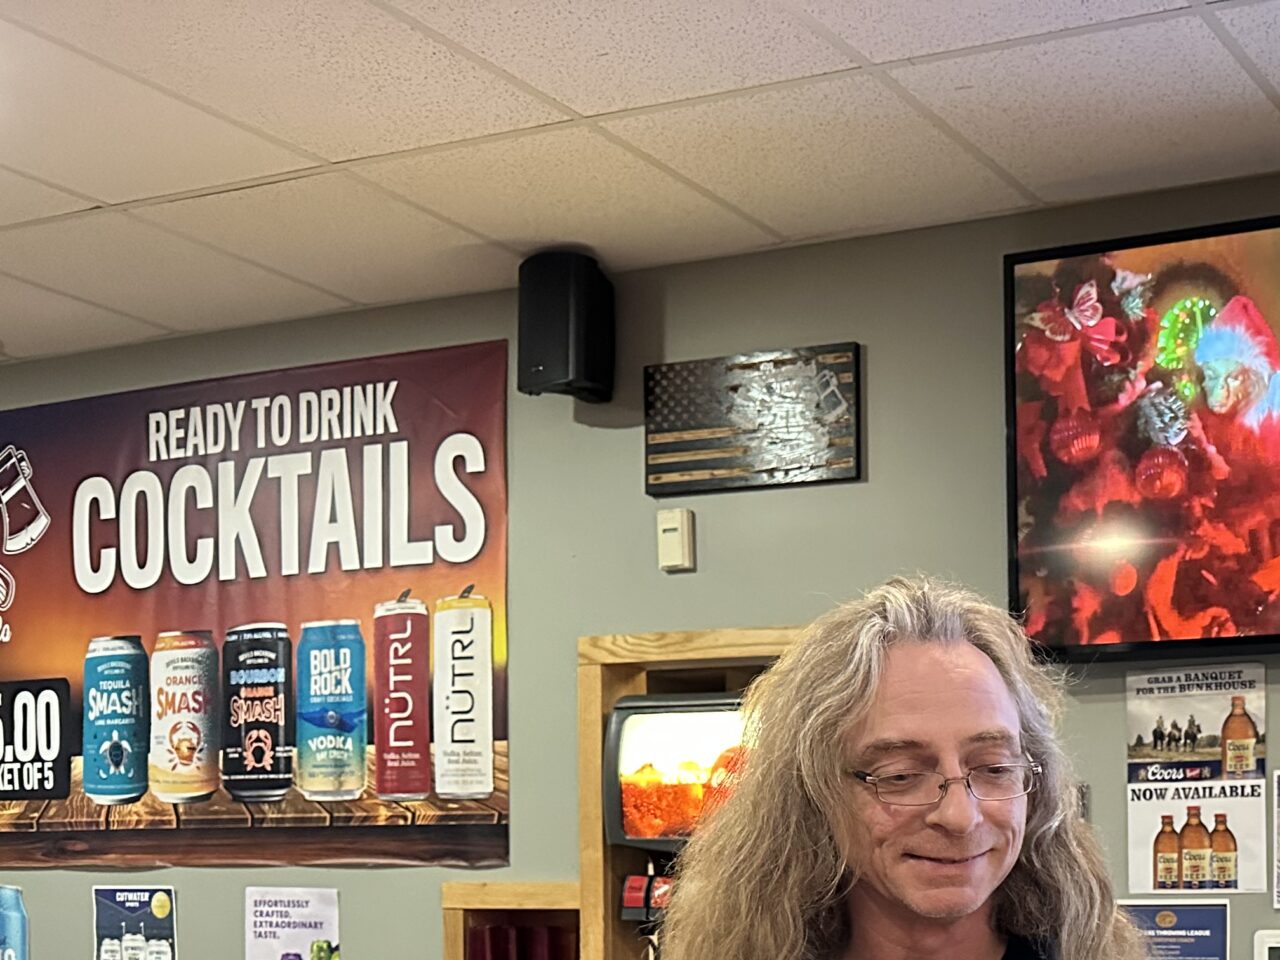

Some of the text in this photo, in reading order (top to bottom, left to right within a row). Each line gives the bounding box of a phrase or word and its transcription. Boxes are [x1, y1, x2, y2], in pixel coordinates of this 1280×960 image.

[149, 380, 399, 461] READY TO DRINK
[72, 432, 486, 594] COCKTAILS
[310, 648, 350, 673] BOLD
[230, 668, 285, 684] BOURBON
[310, 668, 352, 695] ROCK
[1147, 676, 1173, 684] GRAB
[1184, 671, 1243, 682] BANQUET
[99, 680, 130, 691] TEQUILA
[1136, 680, 1256, 695] FOR THE BUNKHOUSE
[88, 685, 143, 720] SMASH
[230, 694, 284, 727] SMASH
[308, 736, 353, 750] VODKA
[23, 761, 54, 791] OF 5
[1147, 764, 1184, 780] Coors
[1131, 785, 1261, 801] NOW AVAILABLE
[116, 892, 149, 901] CUTWATER
[253, 900, 310, 908] EFFORTLESSLY
[253, 921, 324, 929] EXTRAORDINARY
[253, 931, 280, 939] TASTE.
